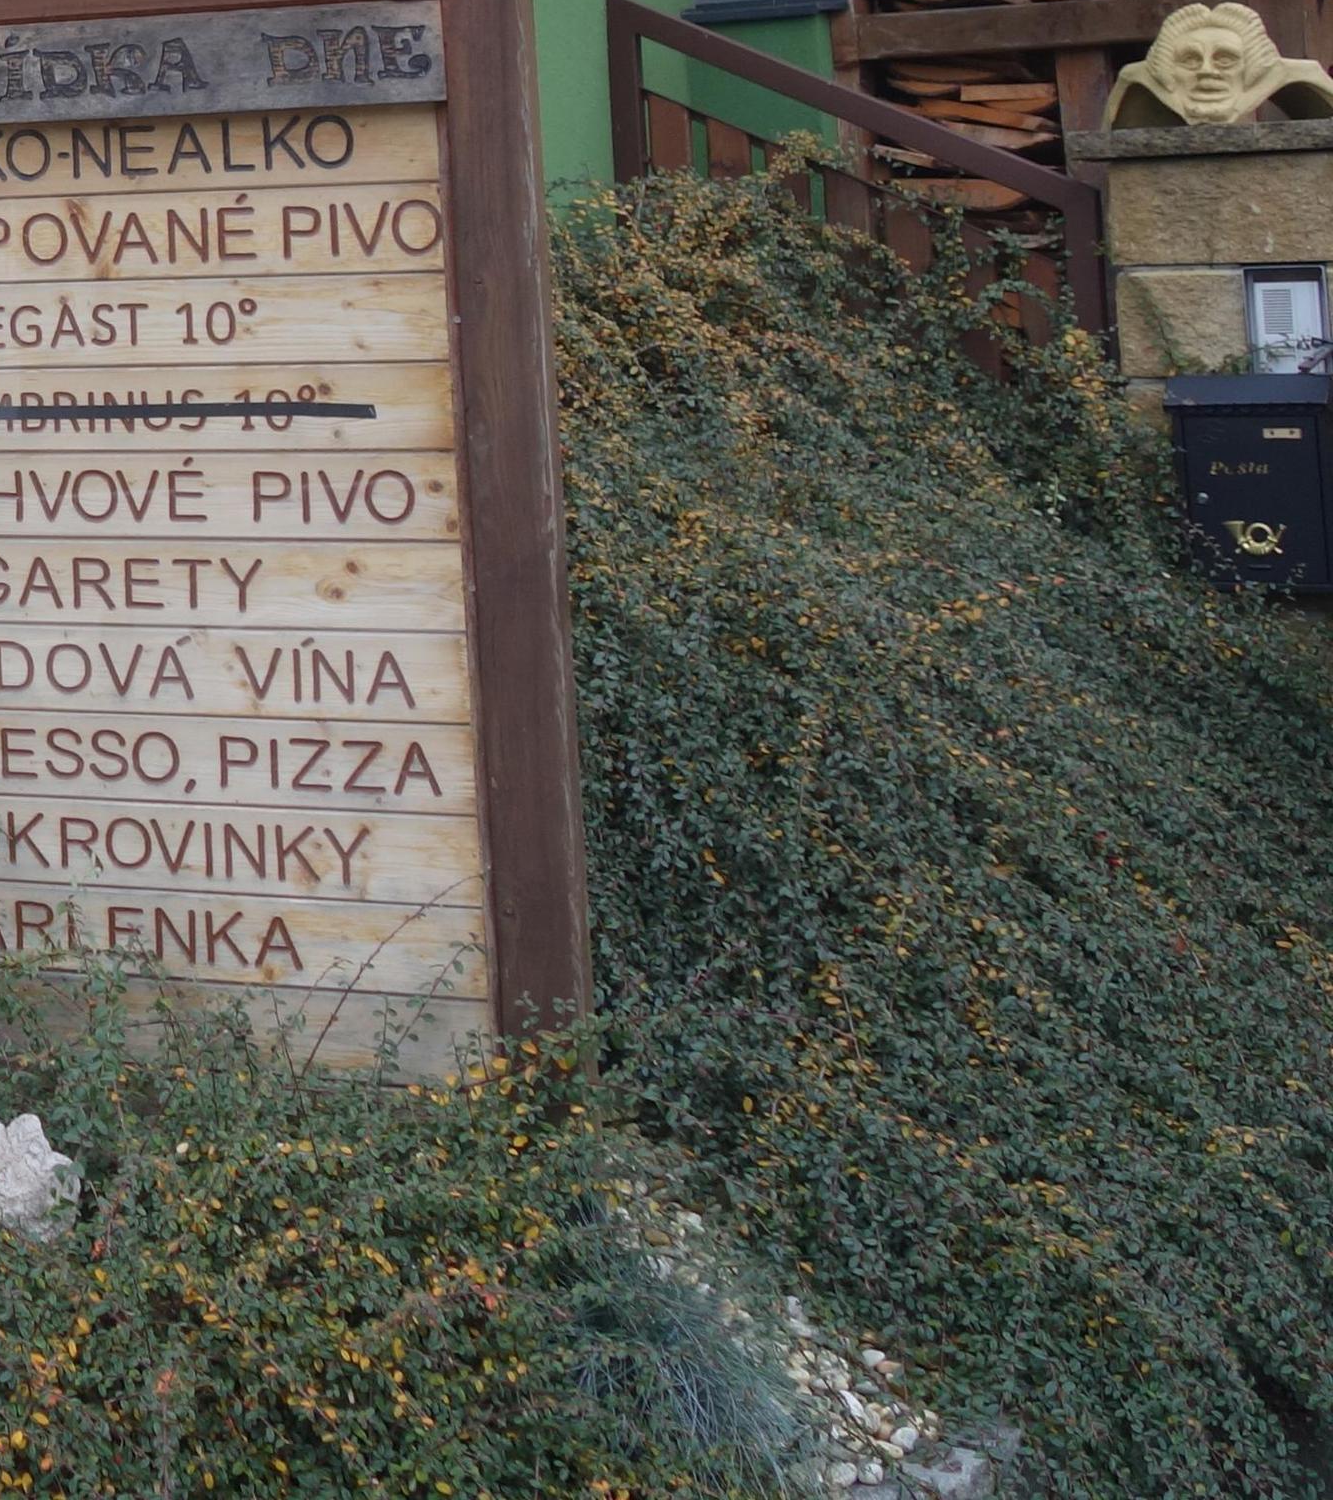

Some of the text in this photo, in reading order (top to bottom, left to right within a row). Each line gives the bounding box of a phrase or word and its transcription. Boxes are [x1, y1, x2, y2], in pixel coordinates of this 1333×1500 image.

[260, 24, 432, 88] DNE
[281, 199, 444, 260] PIVO
[251, 469, 417, 525] PIVO
[235, 636, 417, 709] VÍNA
[219, 735, 443, 797] PIZZA
